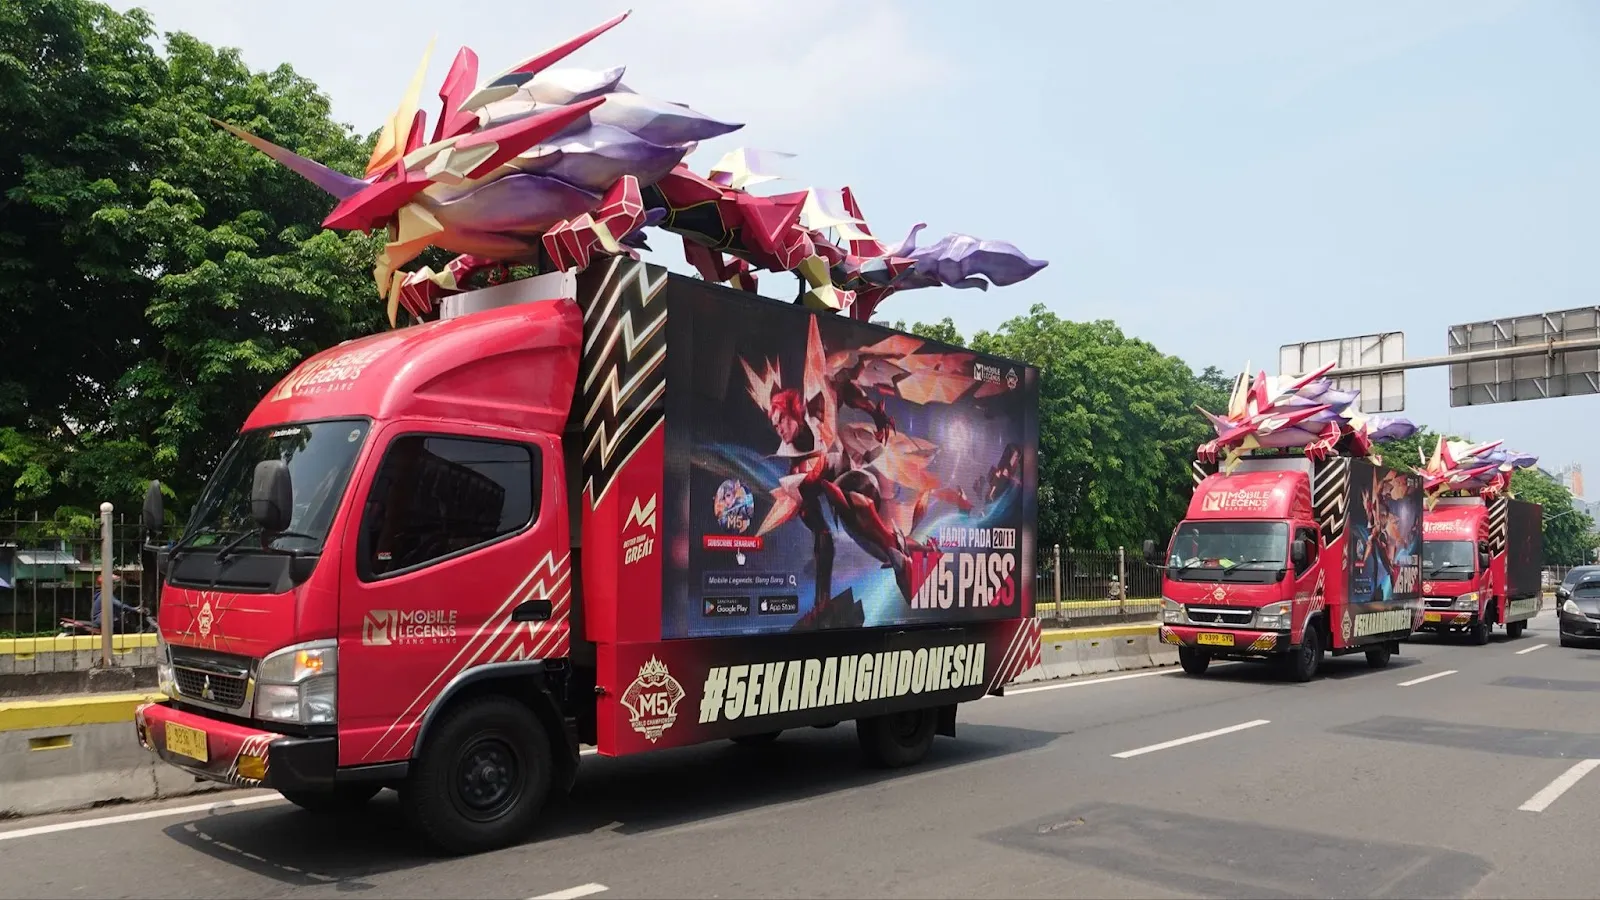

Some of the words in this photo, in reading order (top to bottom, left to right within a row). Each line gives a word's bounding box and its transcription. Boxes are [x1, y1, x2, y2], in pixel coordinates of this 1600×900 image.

[300, 364, 366, 387] LEGENDS
[1227, 489, 1270, 499] MOBILE
[1225, 499, 1268, 507] LEGENDS
[727, 514, 743, 529] M5
[940, 527, 967, 548] HADIR
[968, 528, 991, 548] PADA
[993, 528, 1015, 549] 20/11
[625, 537, 655, 565] GREAT
[708, 576, 728, 584] Mobile
[754, 576, 770, 586] Bang
[769, 576, 785, 586] Bang
[911, 551, 954, 610] M5
[958, 552, 1016, 608] PASS
[716, 604, 736, 615] Google
[736, 604, 749, 614] Play
[768, 604, 781, 613] App
[781, 603, 796, 612] Store
[400, 609, 458, 624] MOBILE
[399, 625, 457, 638] LEGENDS
[698, 642, 986, 723] #5EKARANGINDONESIA
[639, 691, 669, 718] M5
